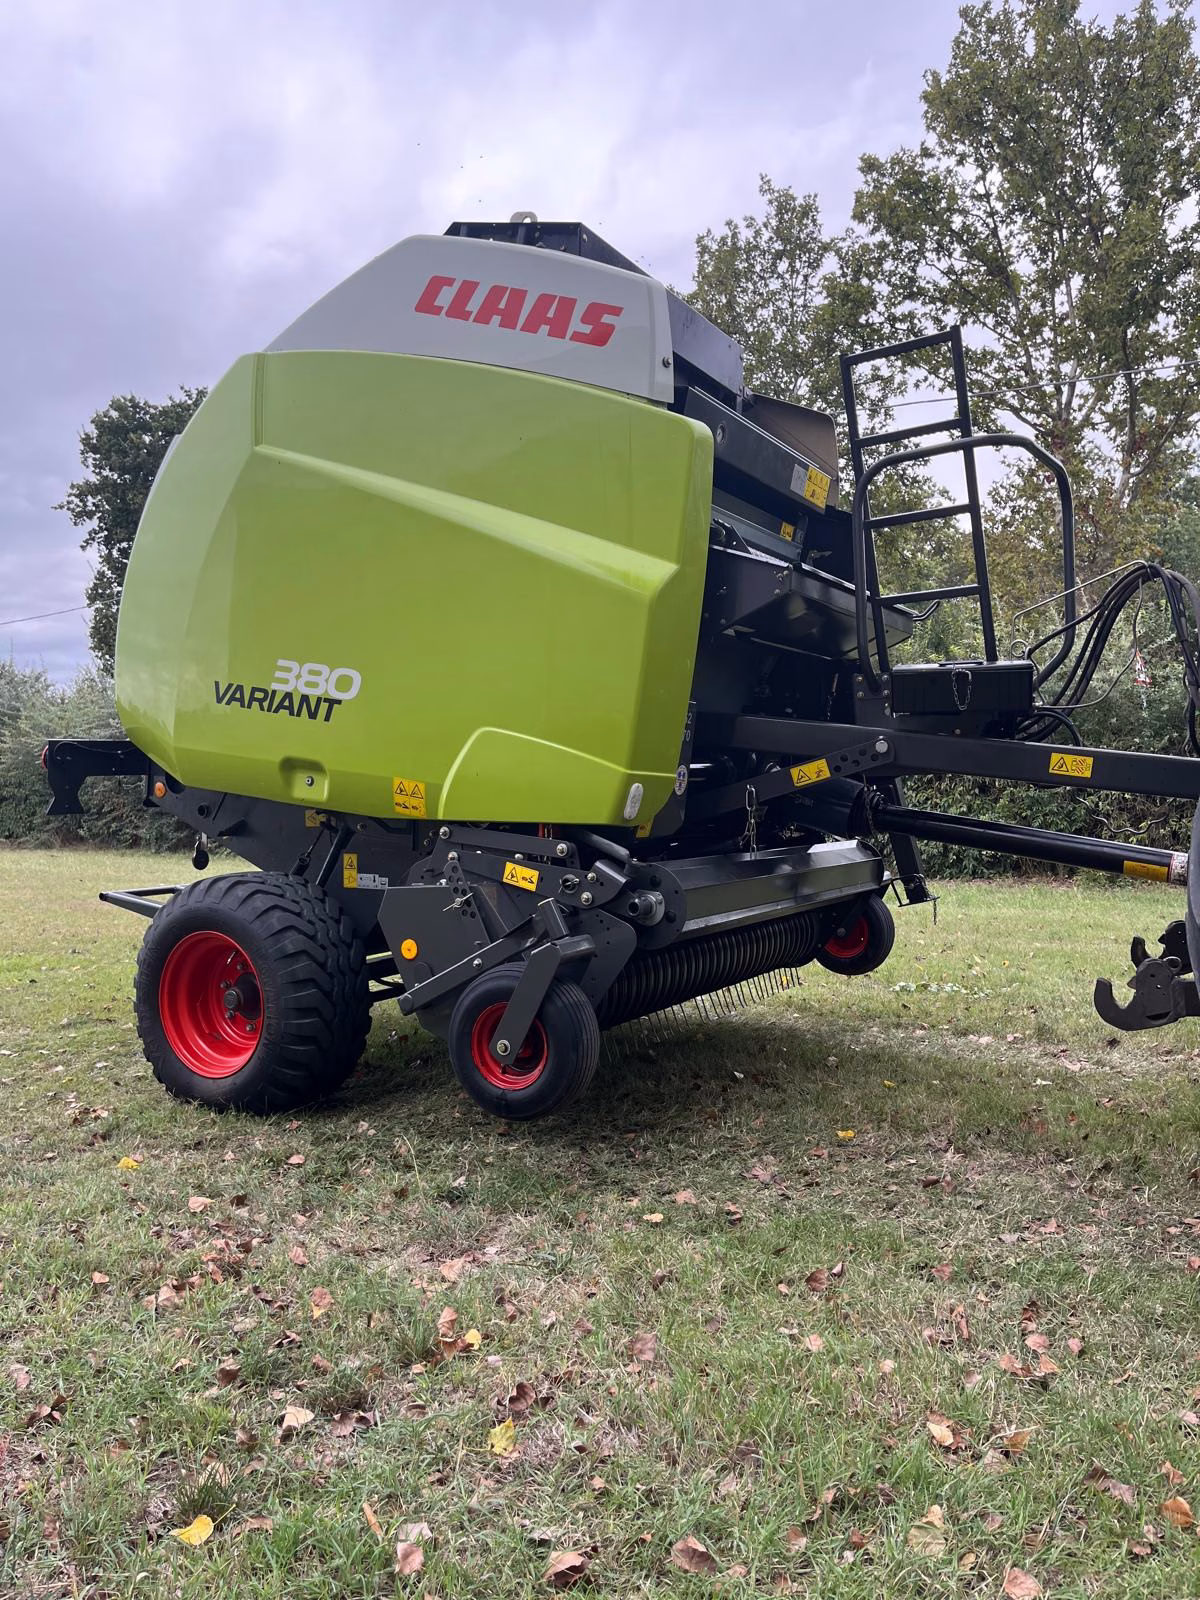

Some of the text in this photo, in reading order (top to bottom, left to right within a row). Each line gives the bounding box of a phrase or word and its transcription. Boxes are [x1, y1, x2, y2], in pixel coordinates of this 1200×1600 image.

[414, 275, 624, 347] CLAAS
[270, 659, 362, 700] 380
[214, 680, 343, 723] VARIANT
